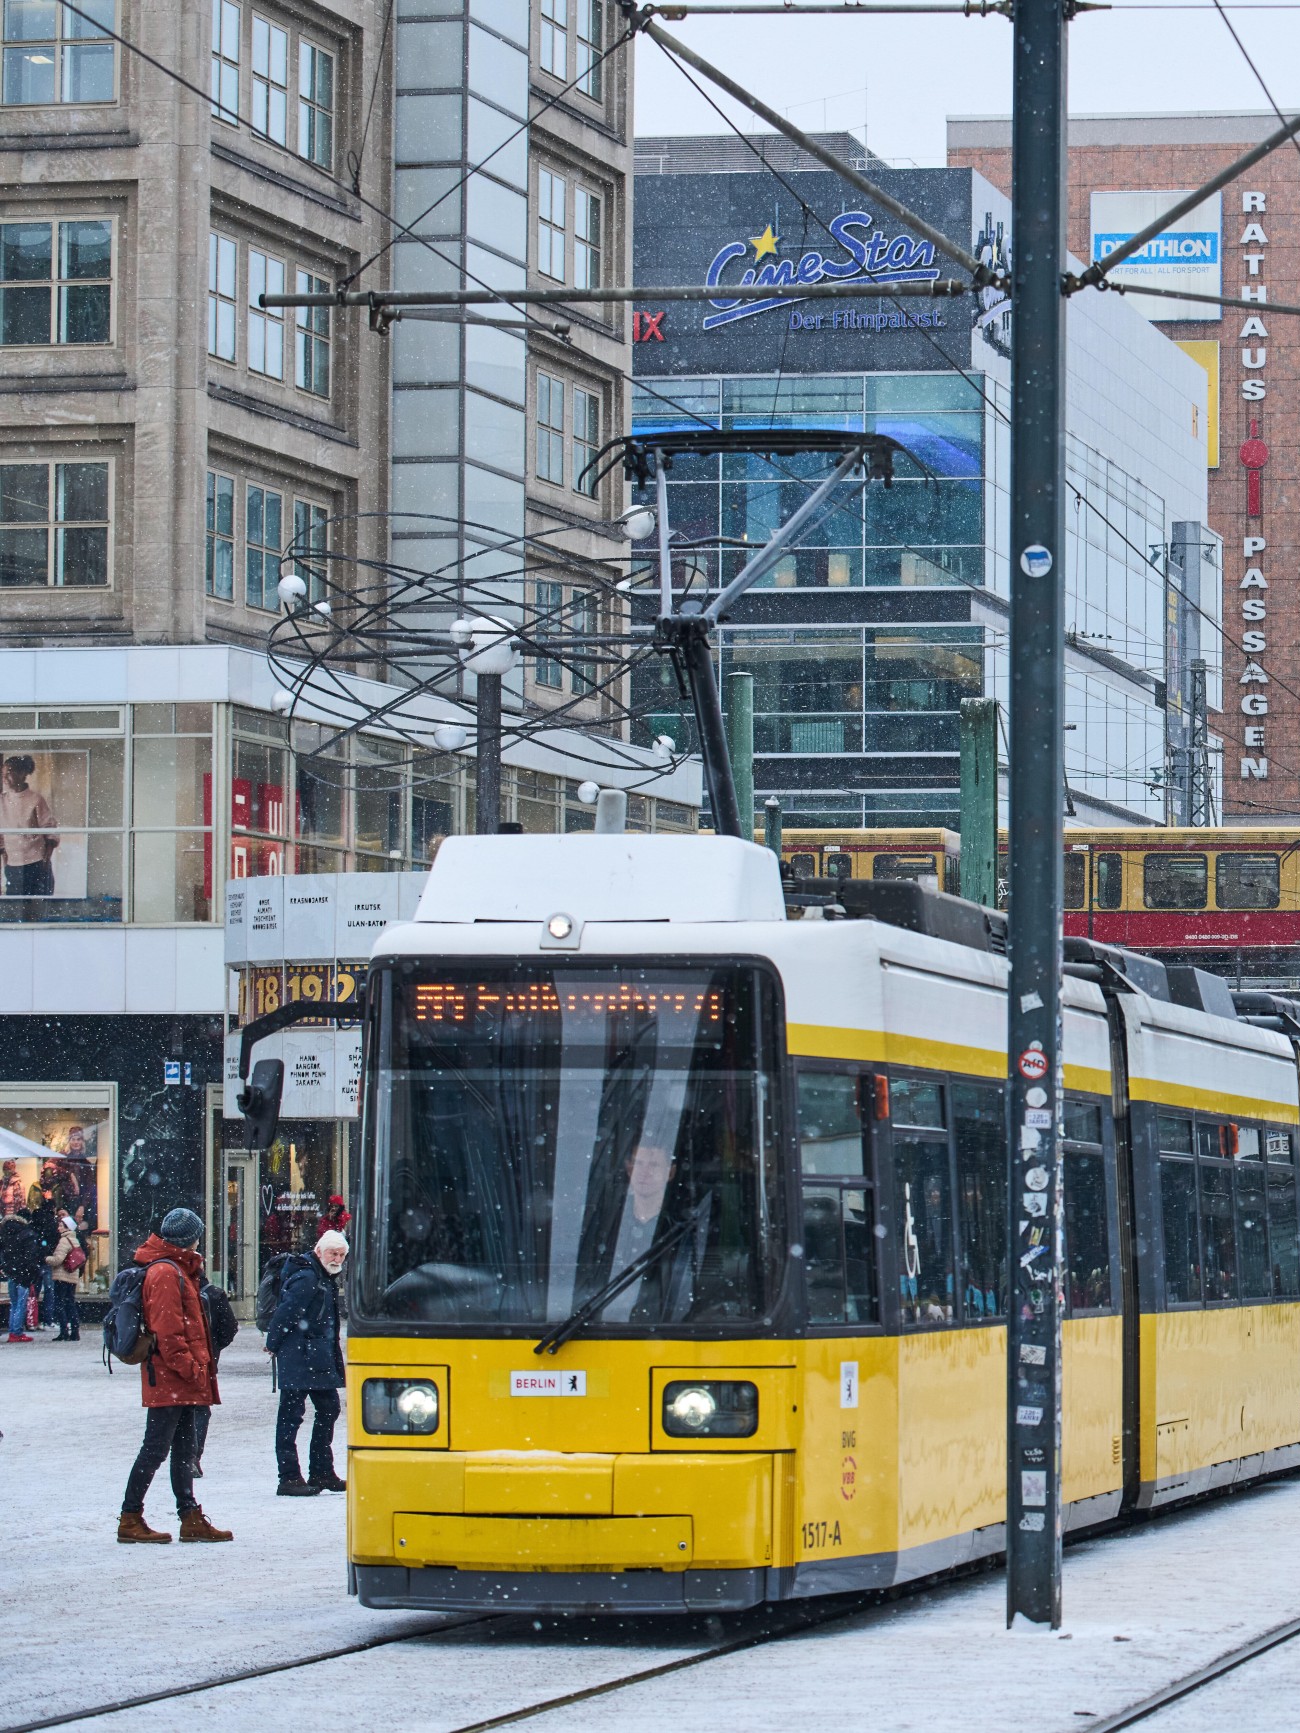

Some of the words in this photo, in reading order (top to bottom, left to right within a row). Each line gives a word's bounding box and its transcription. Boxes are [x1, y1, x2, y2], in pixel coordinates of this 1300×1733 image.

[1100, 239, 1212, 258] DATHLON
[1157, 267, 1171, 275] ALL
[1172, 266, 1186, 274] FOR
[1187, 266, 1210, 274] SPORT
[1240, 190, 1269, 401] RATHAUS
[788, 311, 825, 330] Der
[1239, 536, 1269, 780] PASSAGEN
[256, 975, 279, 1014] 18
[287, 974, 323, 1002] 19
[331, 974, 356, 1003] 2
[515, 1378, 556, 1389] BERLIN
[841, 1429, 857, 1450] BVG
[842, 1471, 856, 1486] VBB
[801, 1519, 843, 1550] 1517-A
